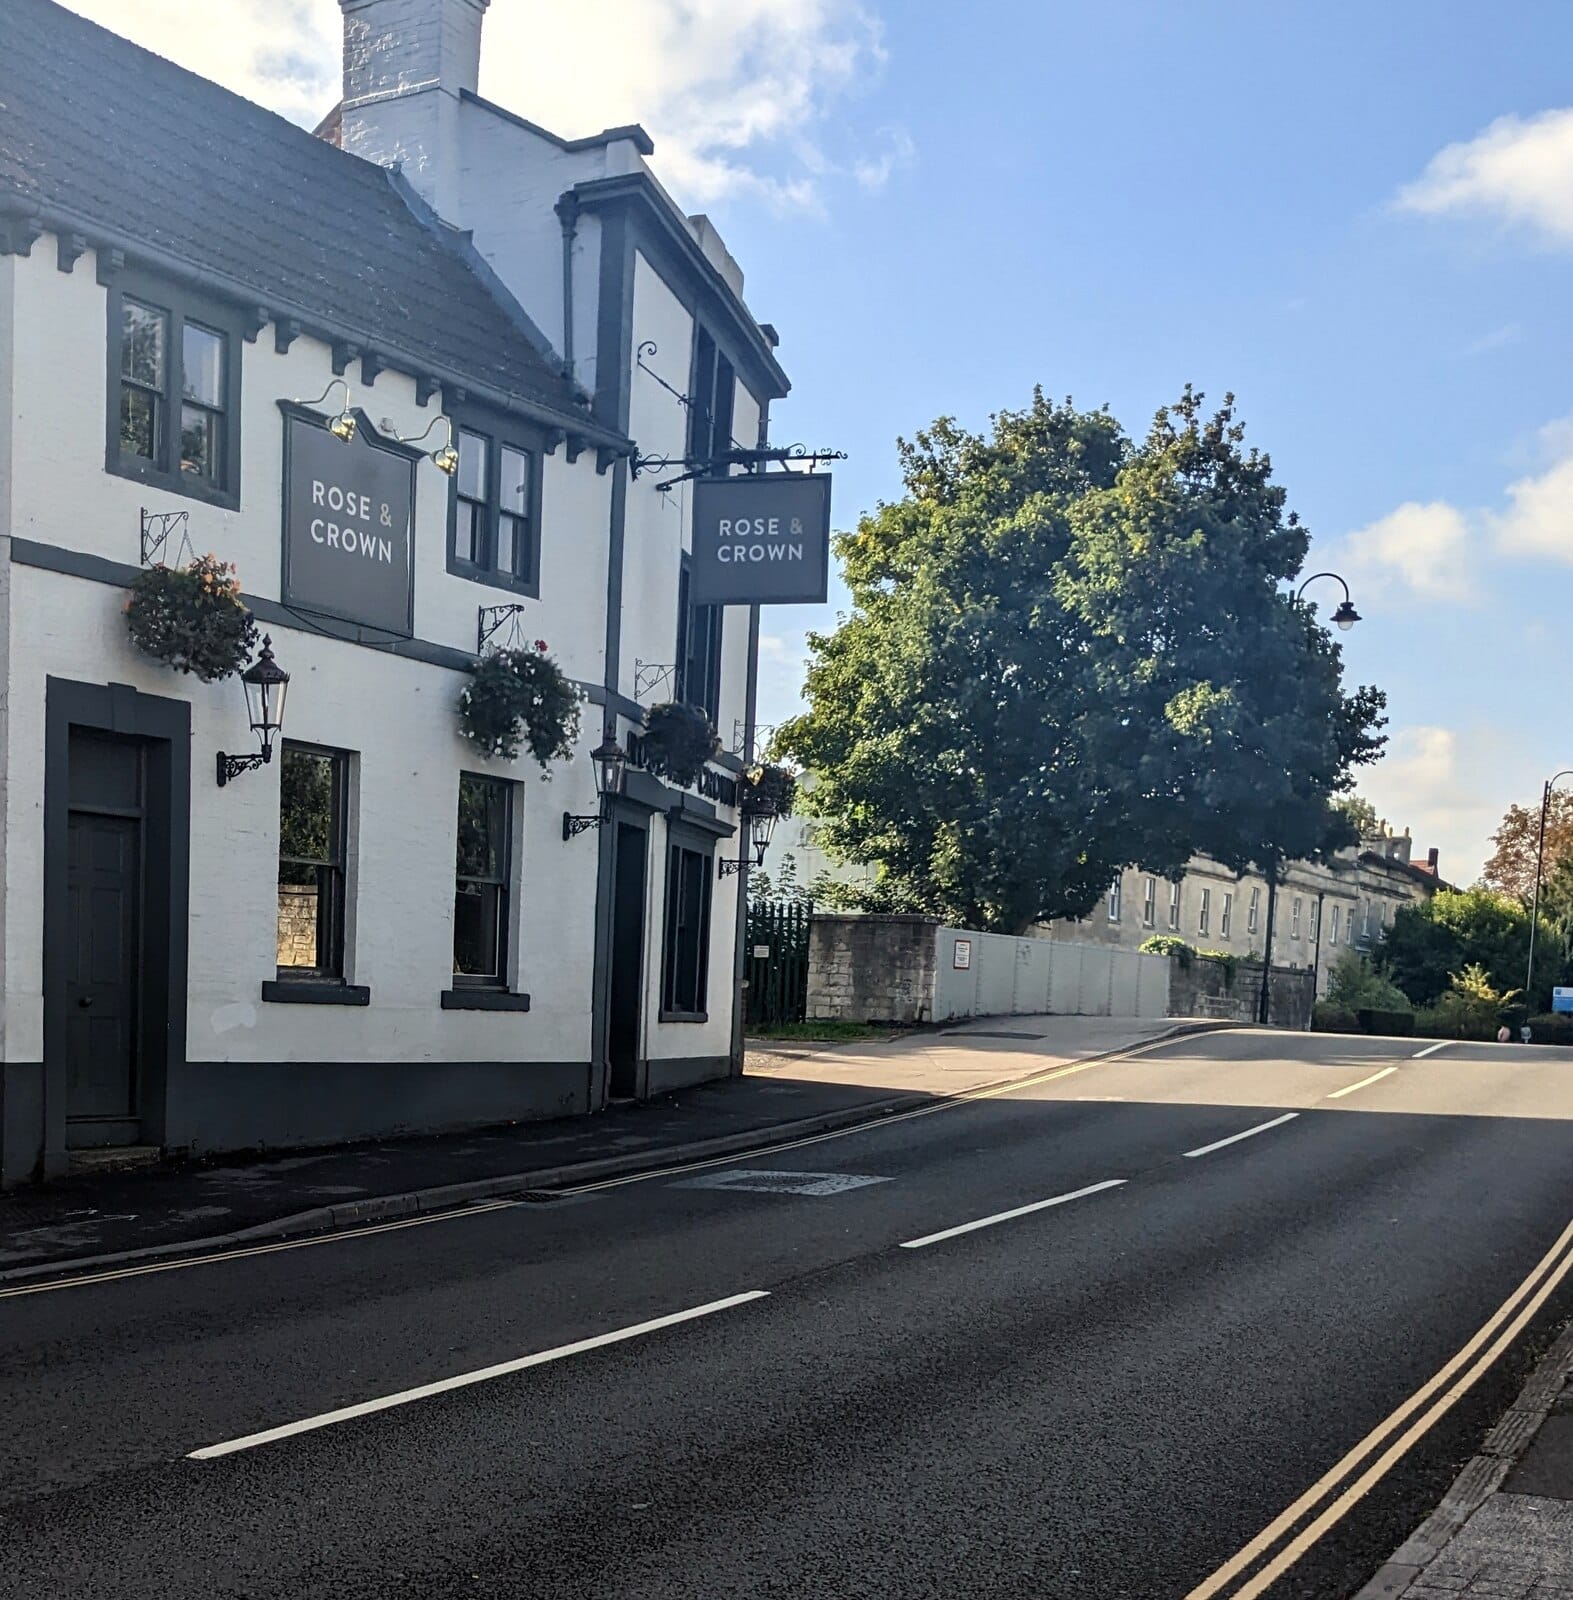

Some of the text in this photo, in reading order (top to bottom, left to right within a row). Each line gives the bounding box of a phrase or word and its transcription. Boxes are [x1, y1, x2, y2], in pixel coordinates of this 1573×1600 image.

[312, 480, 392, 528] ROSE &
[310, 518, 392, 565] CROWN
[718, 517, 803, 537] ROSE &
[717, 543, 803, 563] CROWN
